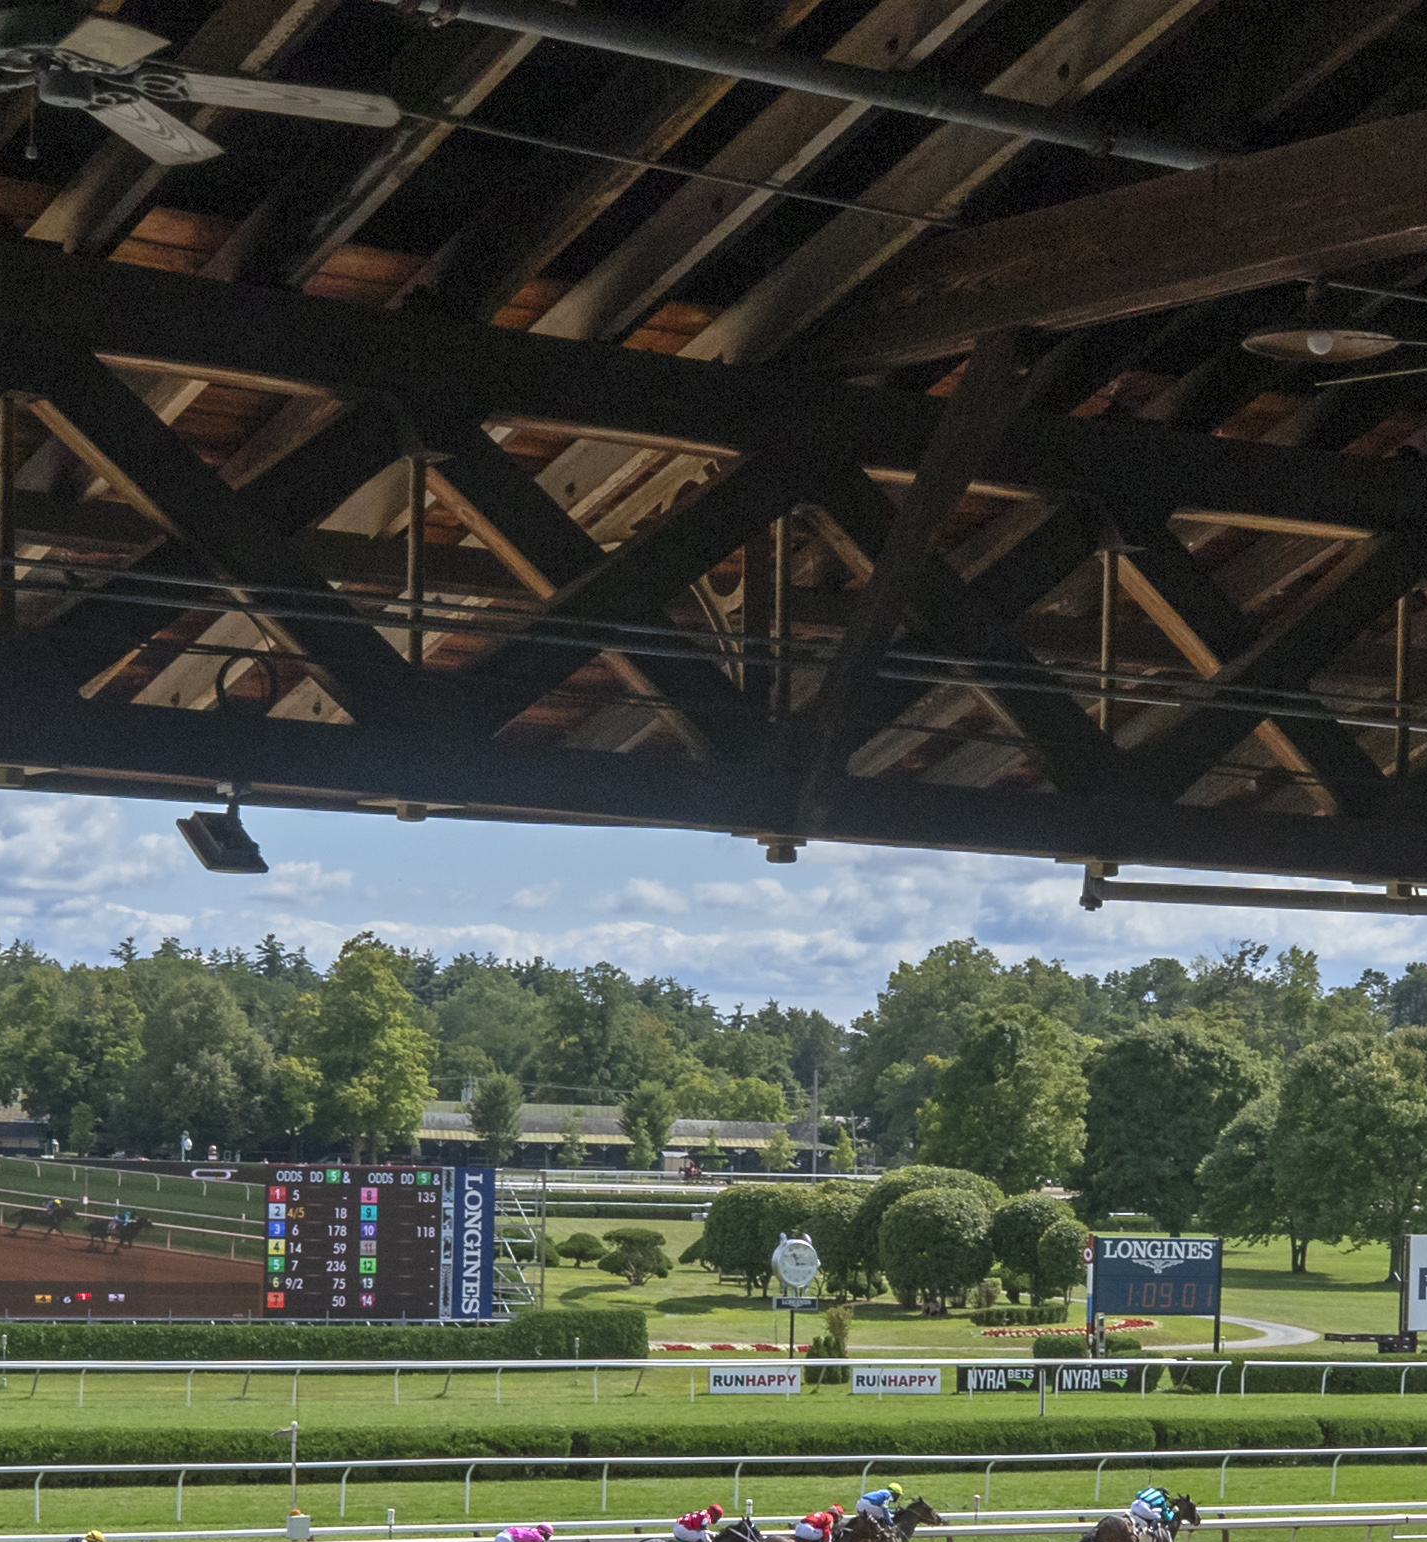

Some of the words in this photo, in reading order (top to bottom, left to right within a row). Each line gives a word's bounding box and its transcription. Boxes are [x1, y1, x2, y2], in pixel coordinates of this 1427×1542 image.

[276, 1171, 303, 1182] ODDS
[310, 1171, 323, 1182] DD
[331, 1171, 337, 1182] 5
[343, 1172, 351, 1183] &
[368, 1173, 393, 1184] ODDS
[401, 1173, 414, 1185] DD
[421, 1173, 427, 1183] 5
[433, 1174, 440, 1185] &
[275, 1189, 280, 1199] 1
[293, 1190, 299, 1200] 5
[417, 1192, 436, 1203] 135
[274, 1207, 280, 1216] 2
[287, 1207, 305, 1218] 4/5
[335, 1208, 347, 1218] 18
[274, 1224, 280, 1235] 3
[292, 1225, 299, 1236] 6
[328, 1225, 347, 1236] 178
[363, 1226, 374, 1236] 10
[417, 1227, 435, 1238] 118
[273, 1242, 280, 1252] 4
[289, 1242, 302, 1254] 14
[333, 1243, 347, 1254] 59
[462, 1173, 483, 1314] LONGINES
[1104, 1240, 1213, 1259] LONGINES
[273, 1259, 279, 1270] 5
[291, 1260, 298, 1271] 7
[326, 1261, 346, 1272] 236
[363, 1261, 372, 1271] 12
[273, 1277, 279, 1288] 6
[285, 1278, 303, 1289] 9/2
[332, 1279, 346, 1289] 75
[363, 1278, 373, 1288] 13
[362, 1296, 372, 1306] 14
[1127, 1282, 1213, 1308] 1:09.01
[332, 1296, 346, 1307] 50
[713, 1375, 797, 1387] RUNHAPPY
[856, 1375, 937, 1387] RUNHAPPY
[967, 1369, 1006, 1389] NYRA
[1008, 1369, 1034, 1378] BETS
[1062, 1370, 1101, 1389] NYRA
[1102, 1369, 1128, 1378] BETS
